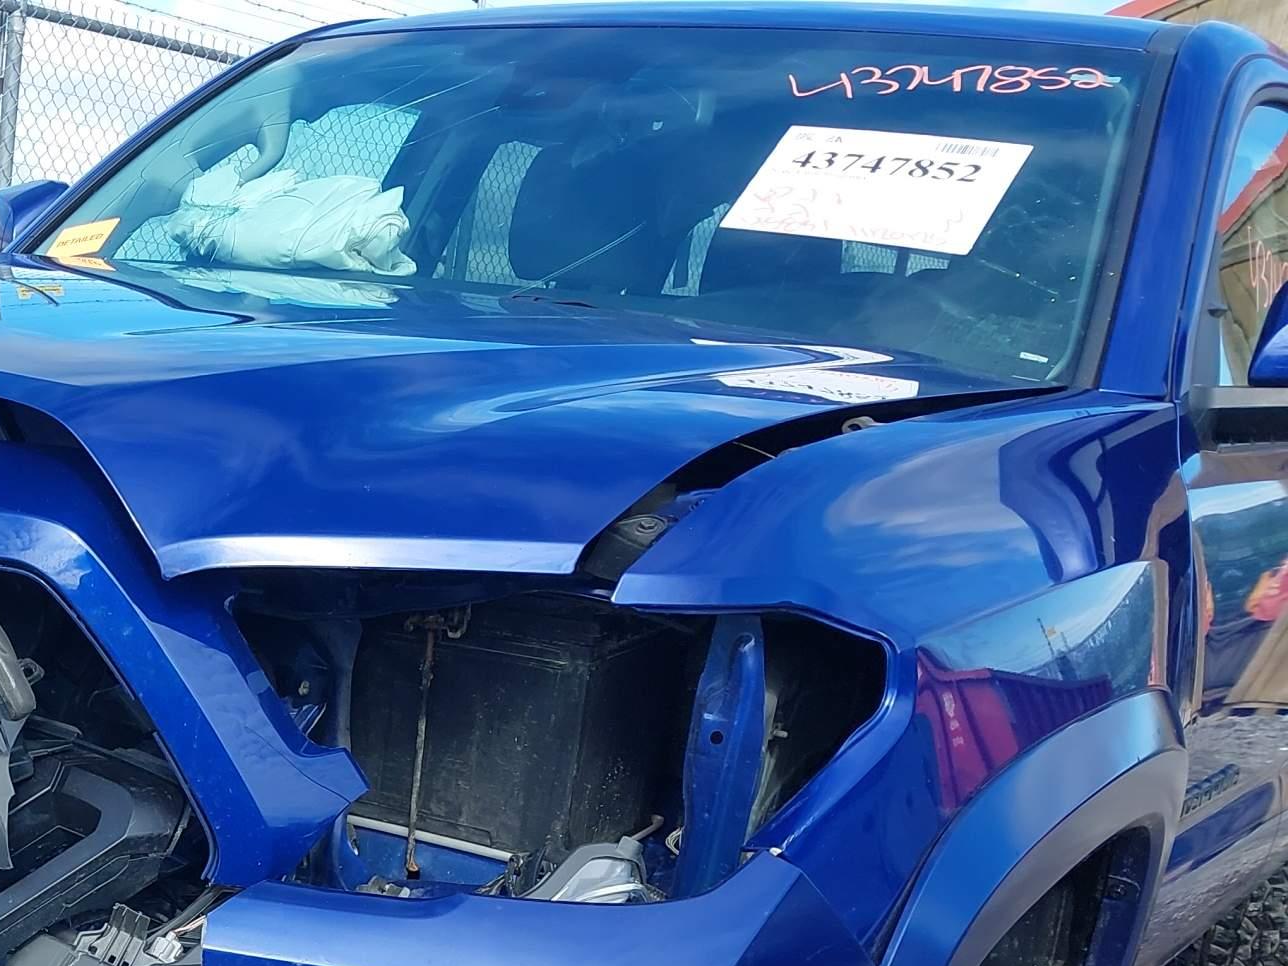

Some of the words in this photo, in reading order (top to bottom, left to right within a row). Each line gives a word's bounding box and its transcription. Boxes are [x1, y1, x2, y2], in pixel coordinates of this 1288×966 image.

[789, 64, 1114, 99] 43747852
[792, 149, 983, 183] 43747852
[56, 233, 105, 248] DETAILED
